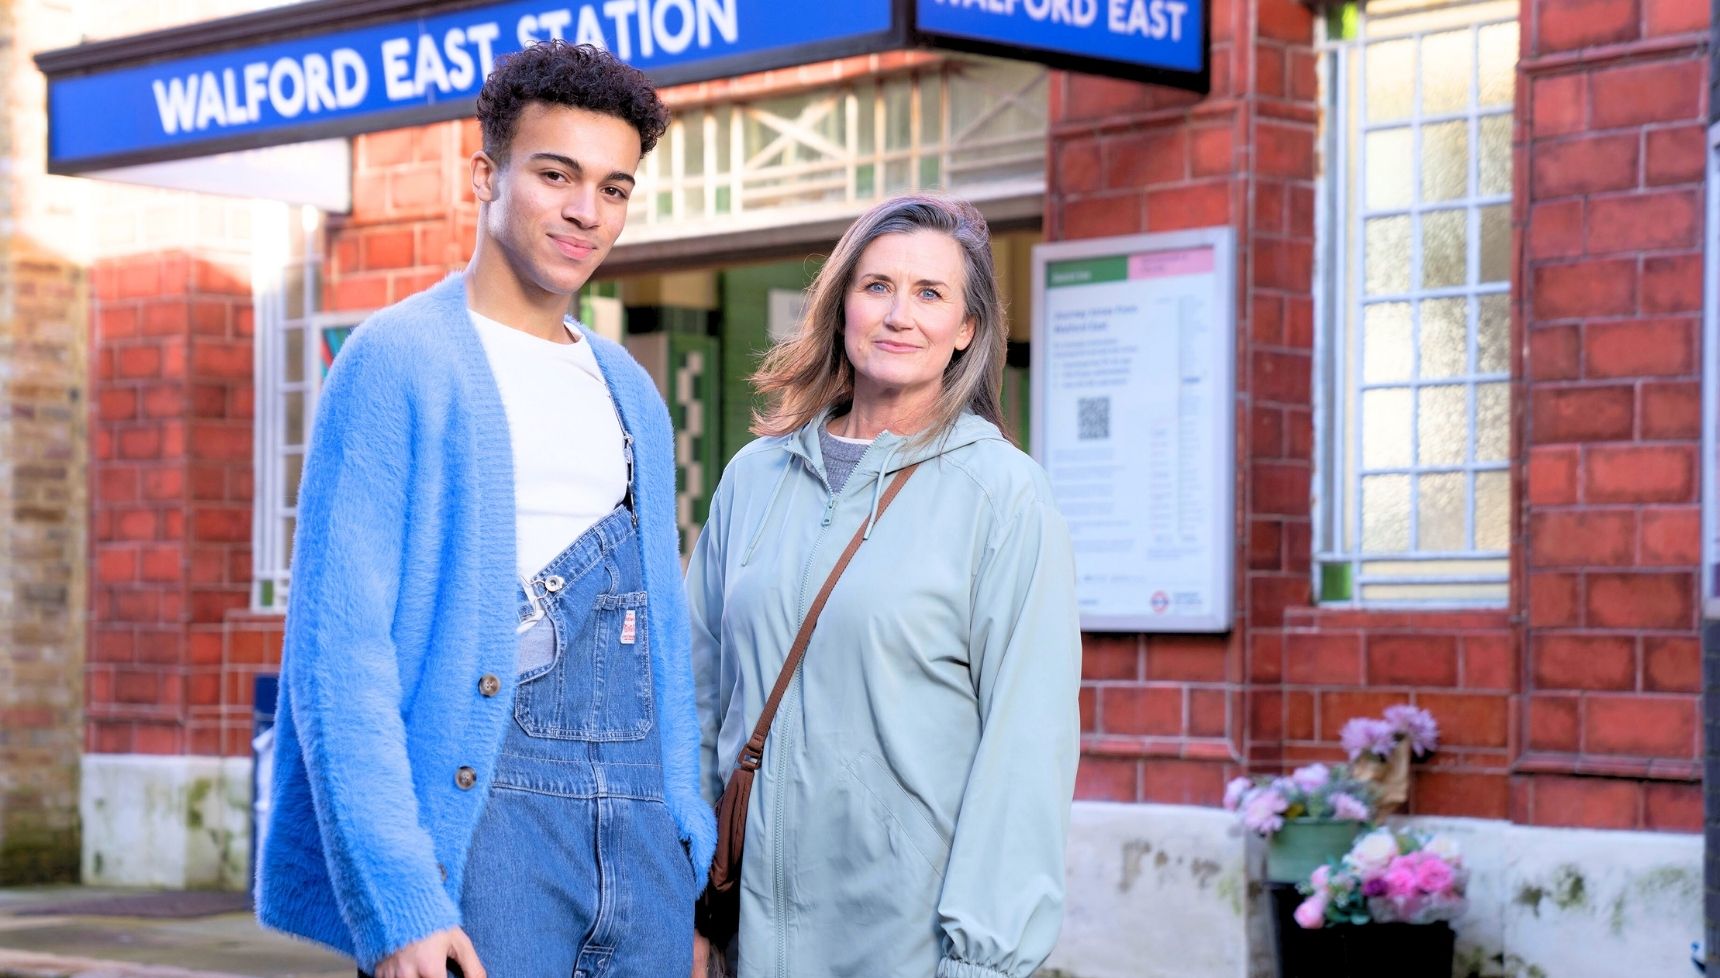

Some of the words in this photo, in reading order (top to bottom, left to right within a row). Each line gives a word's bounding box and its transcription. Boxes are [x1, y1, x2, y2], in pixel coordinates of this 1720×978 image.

[934, 0, 1098, 27] FORD
[1107, 0, 1187, 42] EAST
[152, 48, 368, 135] WALFORD
[381, 22, 499, 101] EAST
[516, 0, 738, 61] STATION
